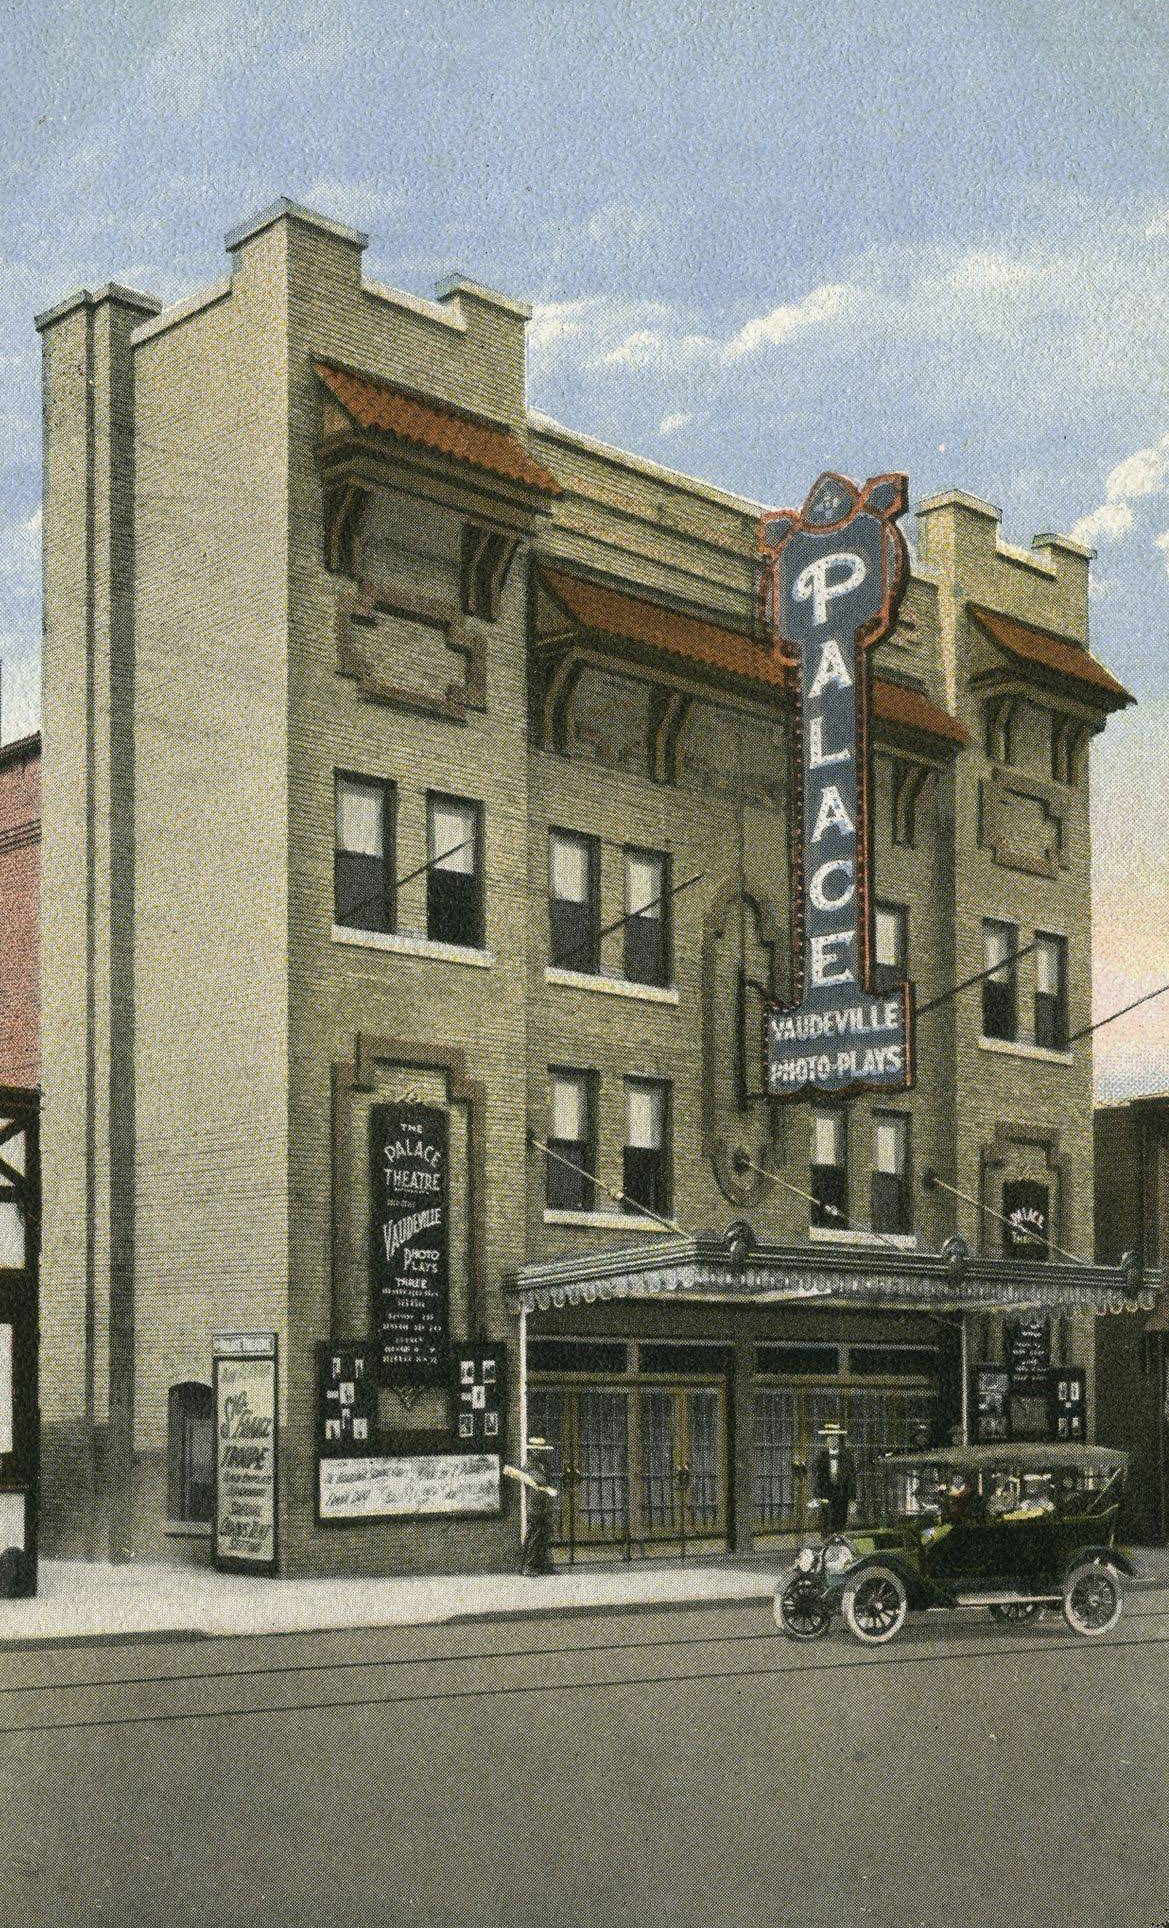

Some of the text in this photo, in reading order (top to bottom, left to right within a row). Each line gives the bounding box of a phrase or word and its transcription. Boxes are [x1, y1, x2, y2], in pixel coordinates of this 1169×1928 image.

[791, 552, 869, 989] PALACE
[770, 1002, 900, 1041] VAUDEVILLE
[400, 1123, 423, 1134] THE
[383, 1138, 442, 1168] PALACE
[383, 1168, 440, 1191] THEATRE
[382, 1207, 442, 1261] VAUDEVILLE
[403, 1247, 440, 1262] PHOTO
[403, 1259, 438, 1273] PLAYS
